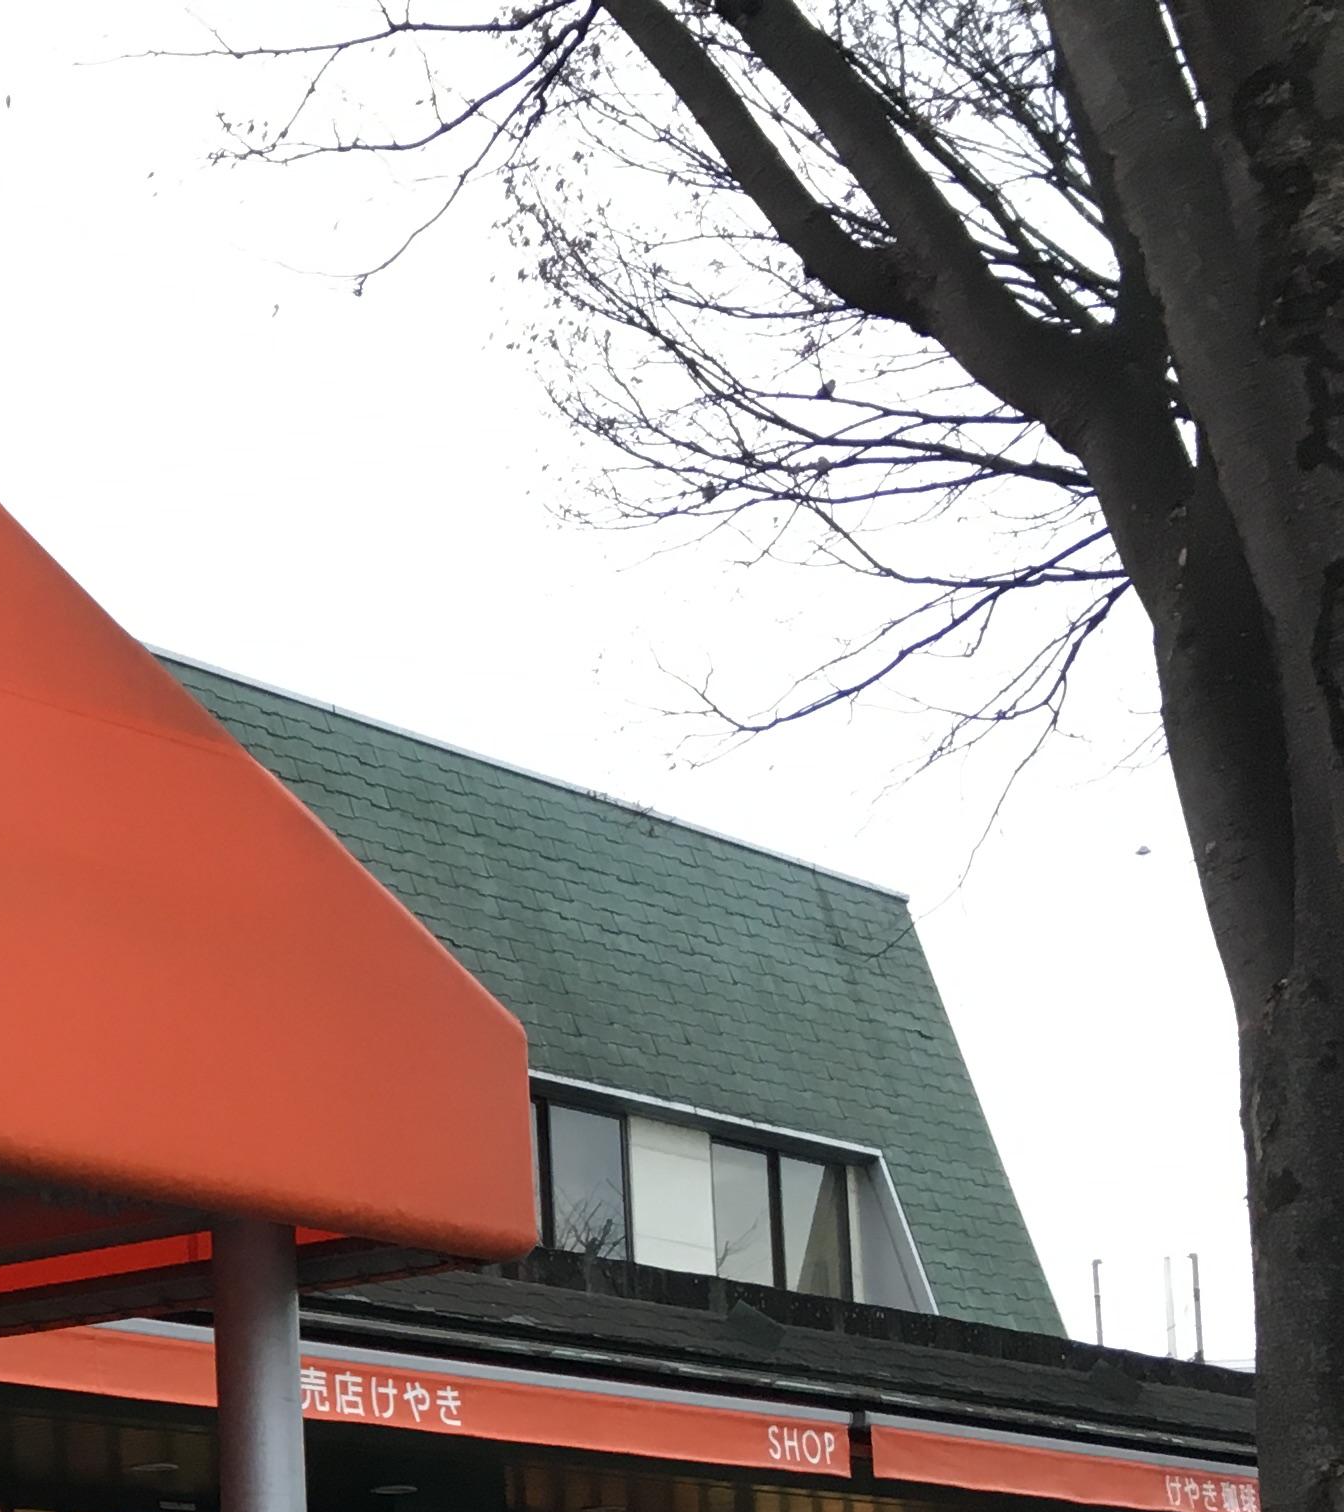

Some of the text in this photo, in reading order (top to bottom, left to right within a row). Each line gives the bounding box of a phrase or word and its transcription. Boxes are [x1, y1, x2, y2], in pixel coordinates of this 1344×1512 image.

[300, 1366, 462, 1427] 売店けやき
[767, 1424, 837, 1466] SHOP
